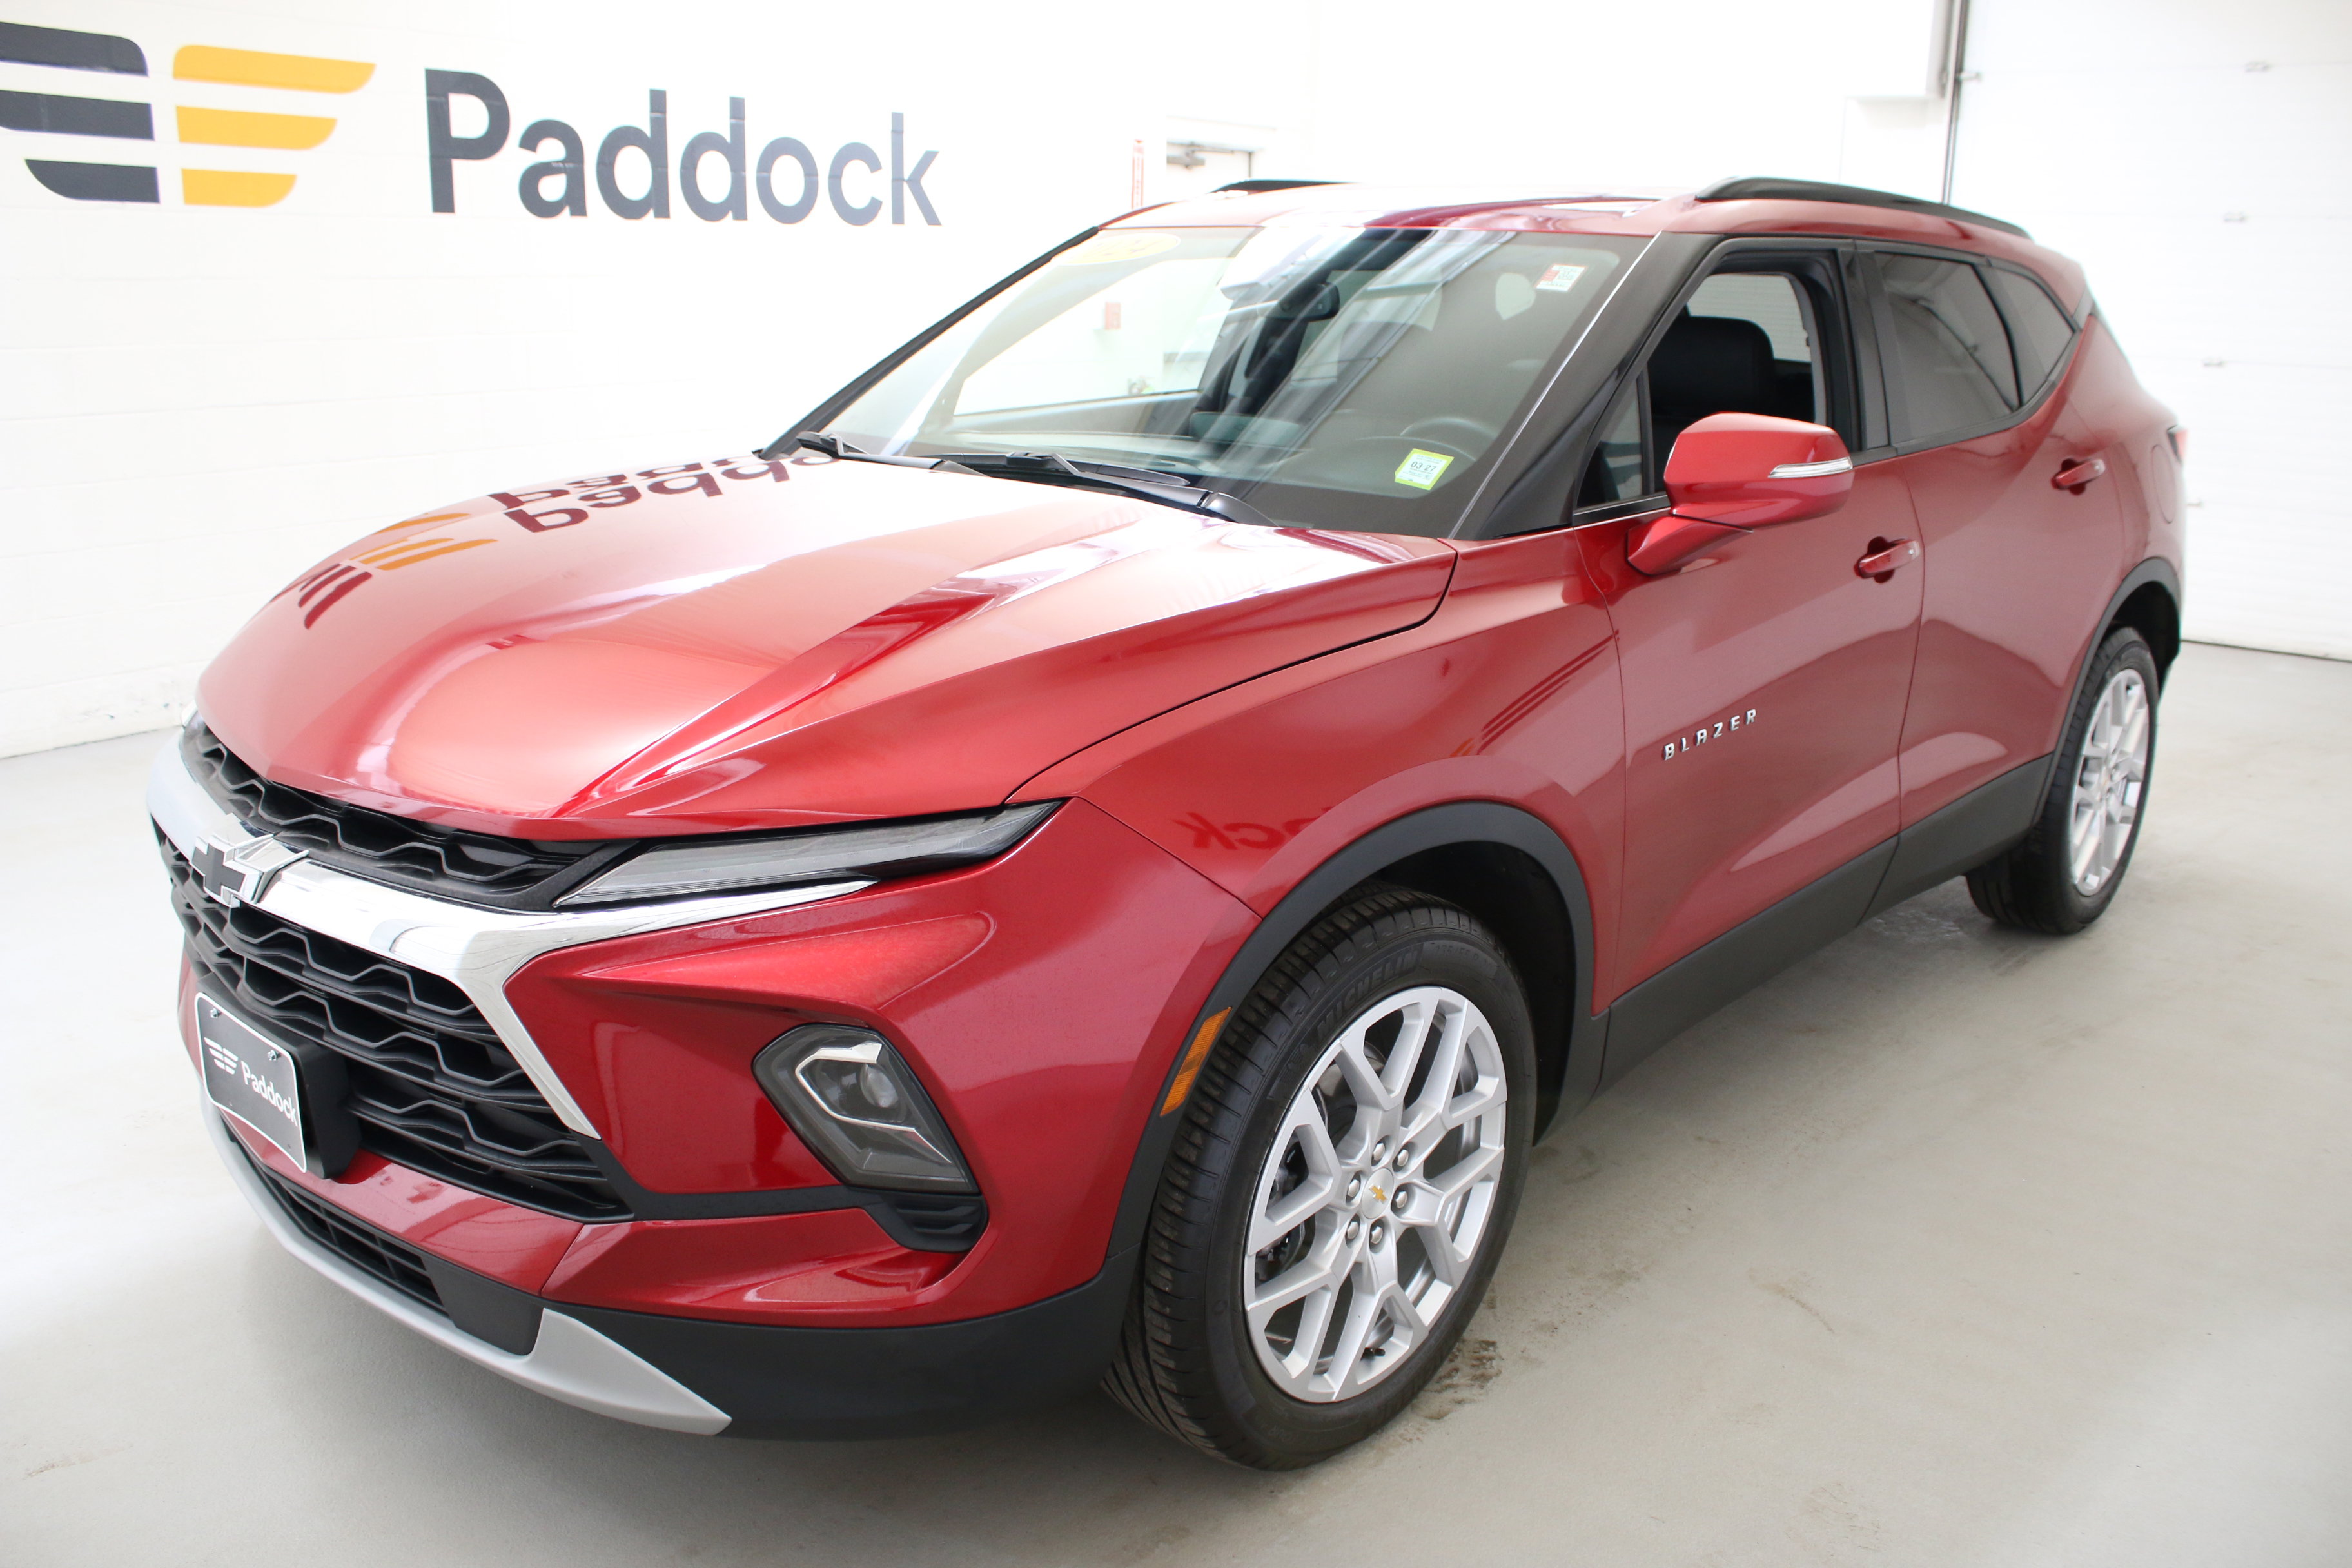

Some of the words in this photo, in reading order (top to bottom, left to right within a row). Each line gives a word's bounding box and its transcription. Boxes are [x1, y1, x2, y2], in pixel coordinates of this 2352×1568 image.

[425, 68, 942, 226] Paddock
[1410, 461, 1424, 470] 03
[1663, 709, 1757, 761] BLAZER
[1317, 949, 1418, 1042] MICHELIN
[240, 1060, 299, 1127] Paddock
